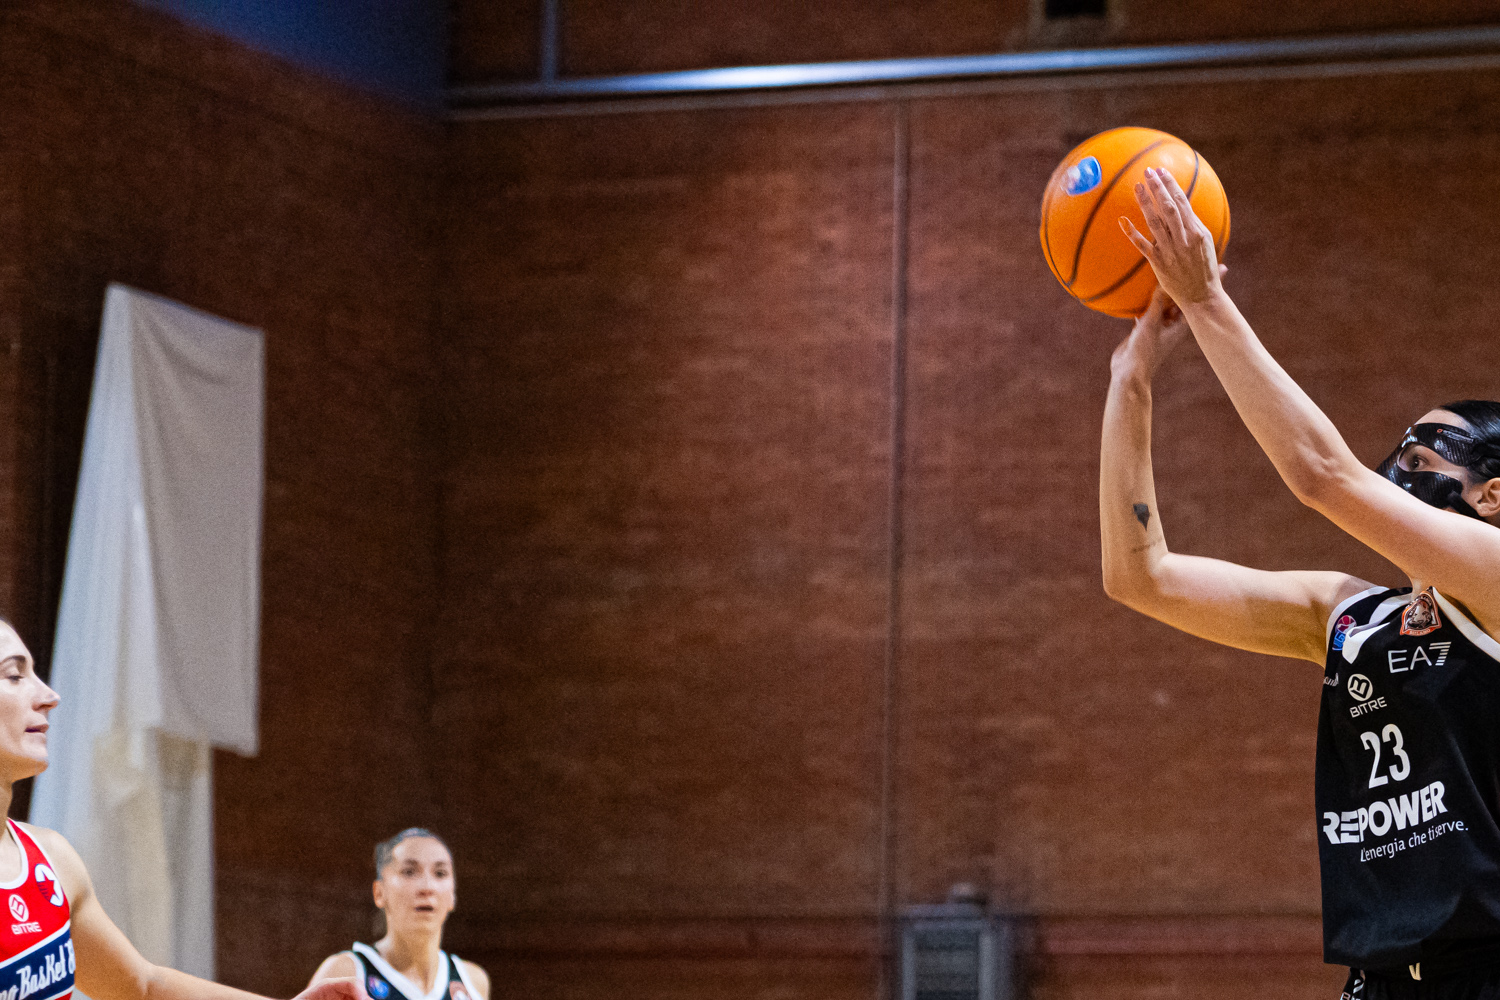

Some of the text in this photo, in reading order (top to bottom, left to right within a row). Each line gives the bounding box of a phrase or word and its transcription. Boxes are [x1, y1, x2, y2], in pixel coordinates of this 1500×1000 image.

[1388, 641, 1451, 674] EA7
[1350, 696, 1388, 718] BITRE
[1360, 723, 1411, 789] 23
[1323, 780, 1449, 845] REPOWER
[1360, 838, 1406, 863] L'energia
[1409, 831, 1427, 848] che
[11, 921, 43, 935] BITRE
